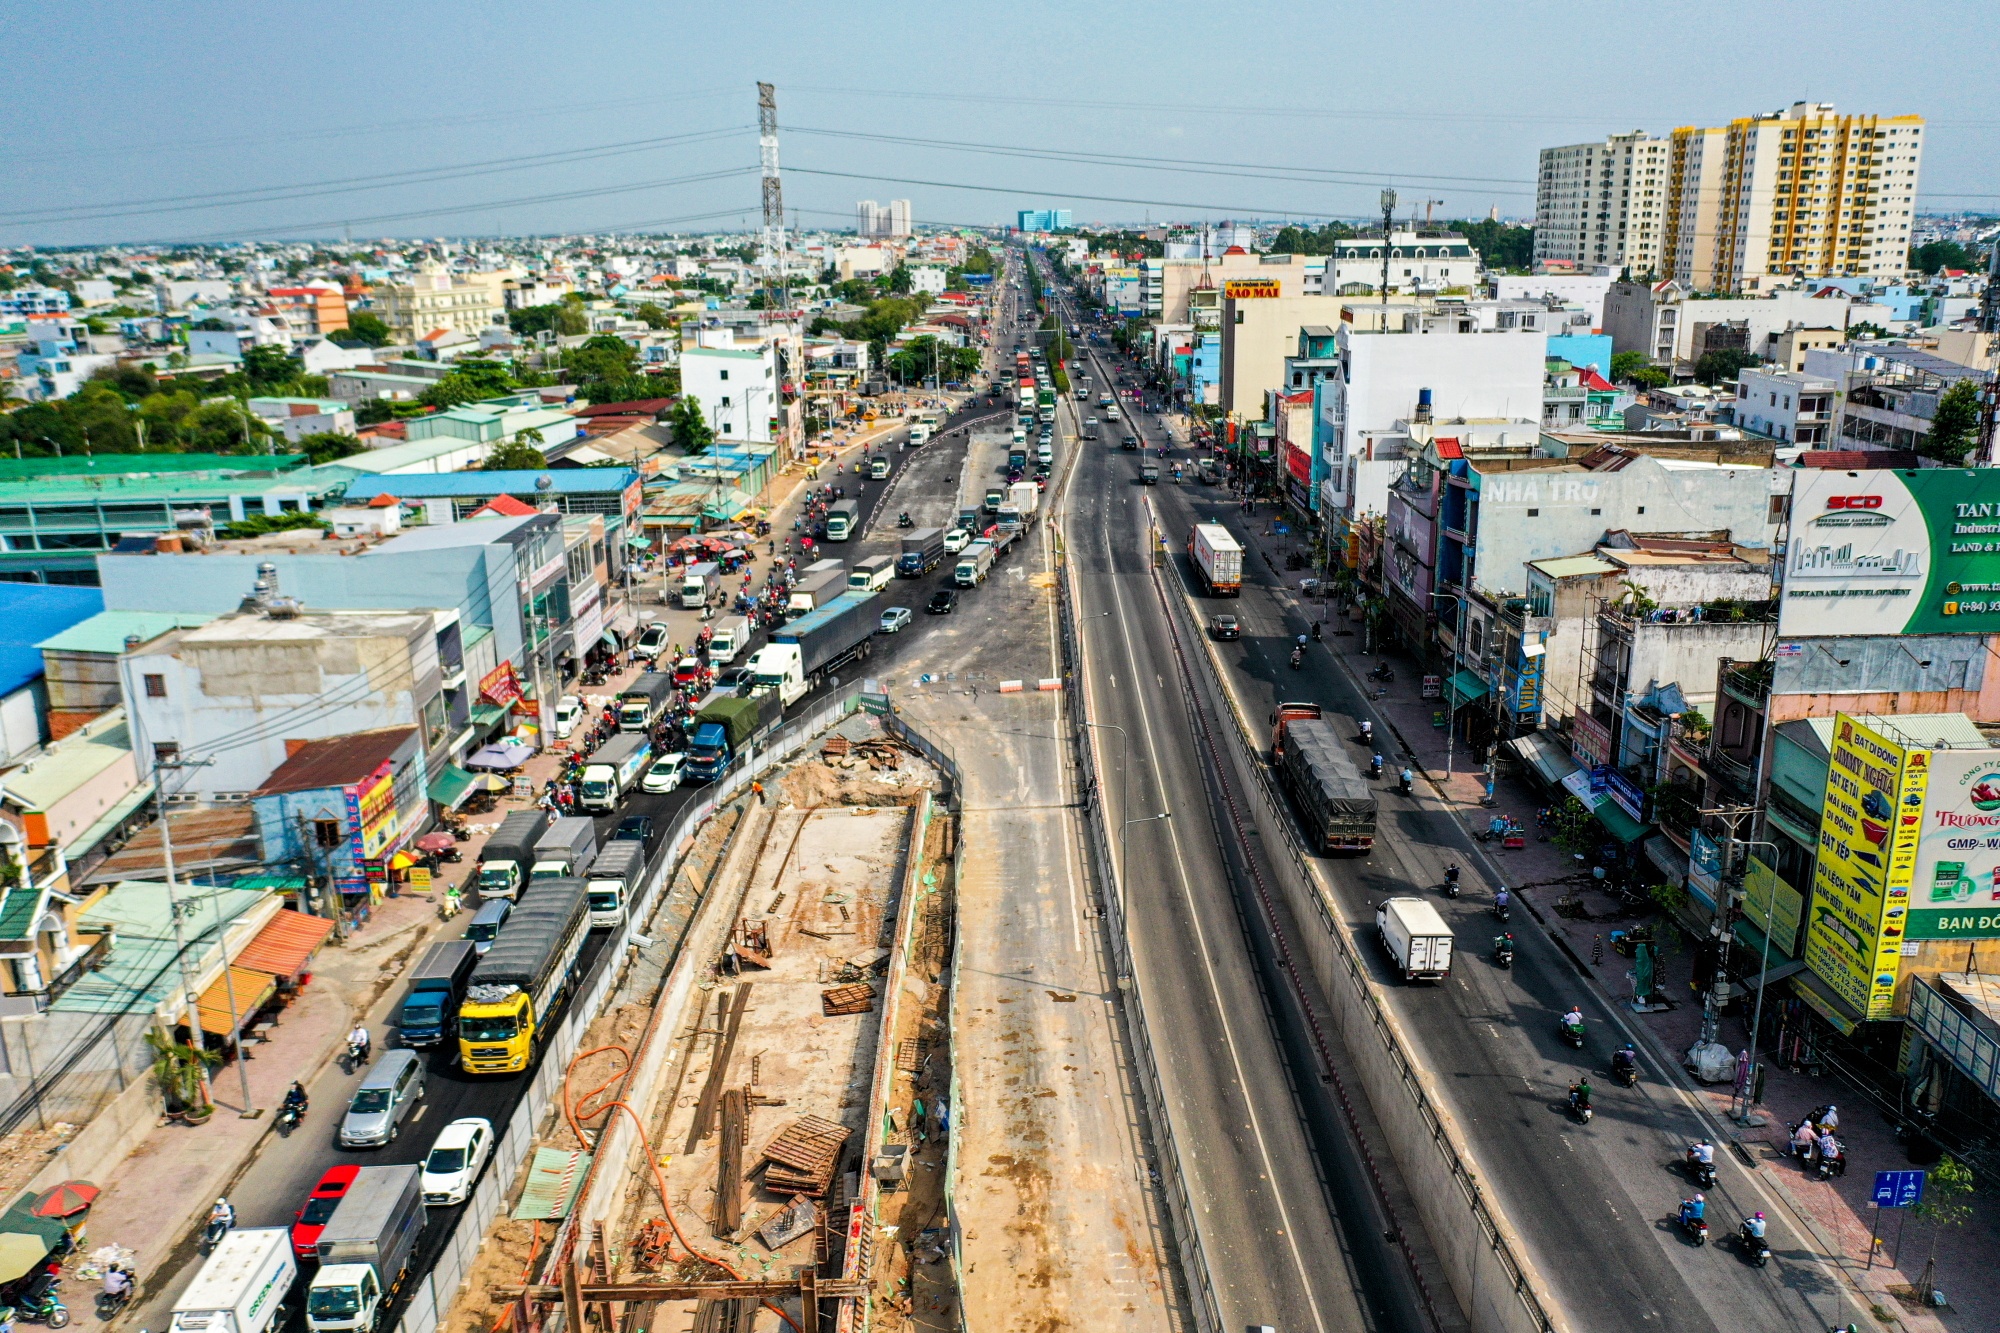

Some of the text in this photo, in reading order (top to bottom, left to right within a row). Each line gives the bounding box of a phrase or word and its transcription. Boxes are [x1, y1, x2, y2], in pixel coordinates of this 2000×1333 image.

[1226, 288, 1279, 298] SAO MAI
[1827, 495, 1883, 509] SCD
[1956, 503, 1992, 518] TAN
[1952, 542, 1994, 552] LAND &
[1789, 589, 1912, 598] SUSTAINABLE DEVELOPMENT
[1959, 601, 1987, 613] (+84)
[1522, 656, 1537, 676] Ga
[1518, 678, 1537, 710] Villa
[1855, 735, 1867, 750] BẠT
[1870, 744, 1876, 753] DI
[1830, 771, 1840, 789] BẠT
[1842, 778, 1848, 791] XE
[1835, 746, 1895, 796] JIMMY NGHĨA
[1959, 765, 1982, 786] CÔNG
[1983, 761, 1994, 769] TY
[1828, 792, 1856, 819] MÁI HIÊN
[1827, 811, 1853, 837] DI ĐỘNG
[1822, 832, 1849, 861] BẠT XẾP
[1947, 838, 1977, 849] GMP
[1828, 869, 1844, 893] LỆCH
[1847, 884, 1860, 903] TÂM
[1938, 916, 1974, 933] BẠN
[249, 1282, 272, 1318] GREEN
